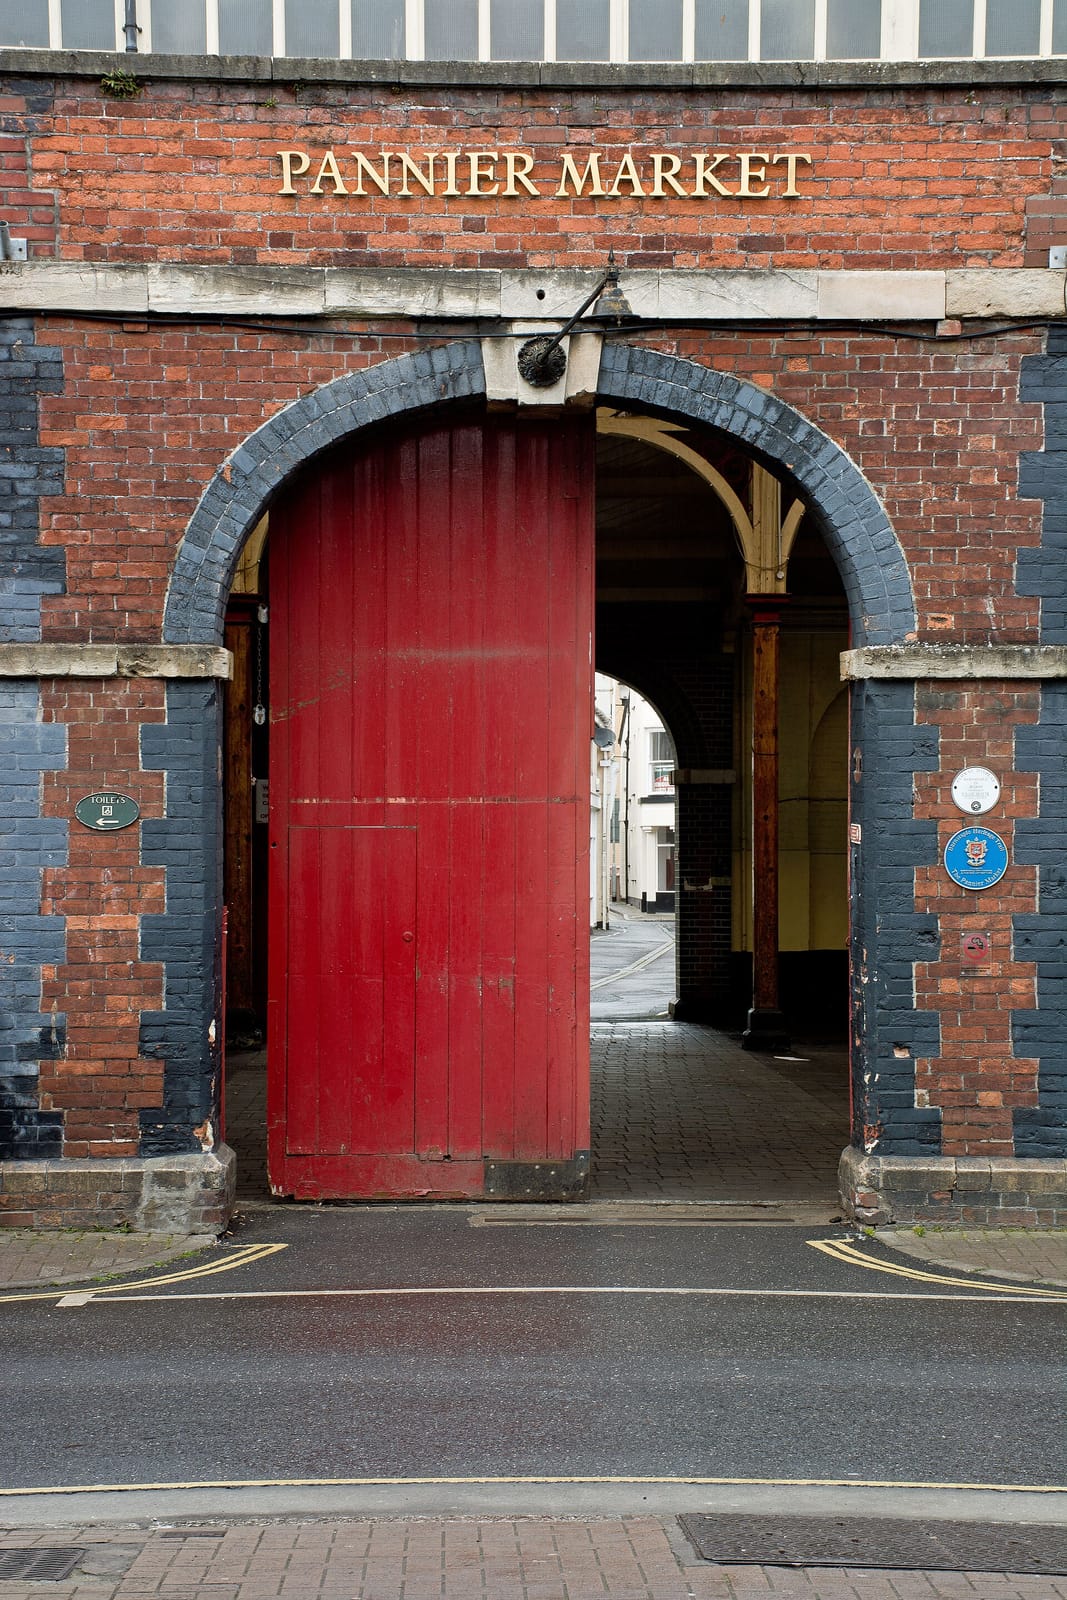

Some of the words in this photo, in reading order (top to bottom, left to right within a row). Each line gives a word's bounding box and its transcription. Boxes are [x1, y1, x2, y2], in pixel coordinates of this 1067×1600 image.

[276, 150, 541, 196] PANNIER
[555, 152, 812, 197] MARKET
[90, 796, 126, 804] TOILETS
